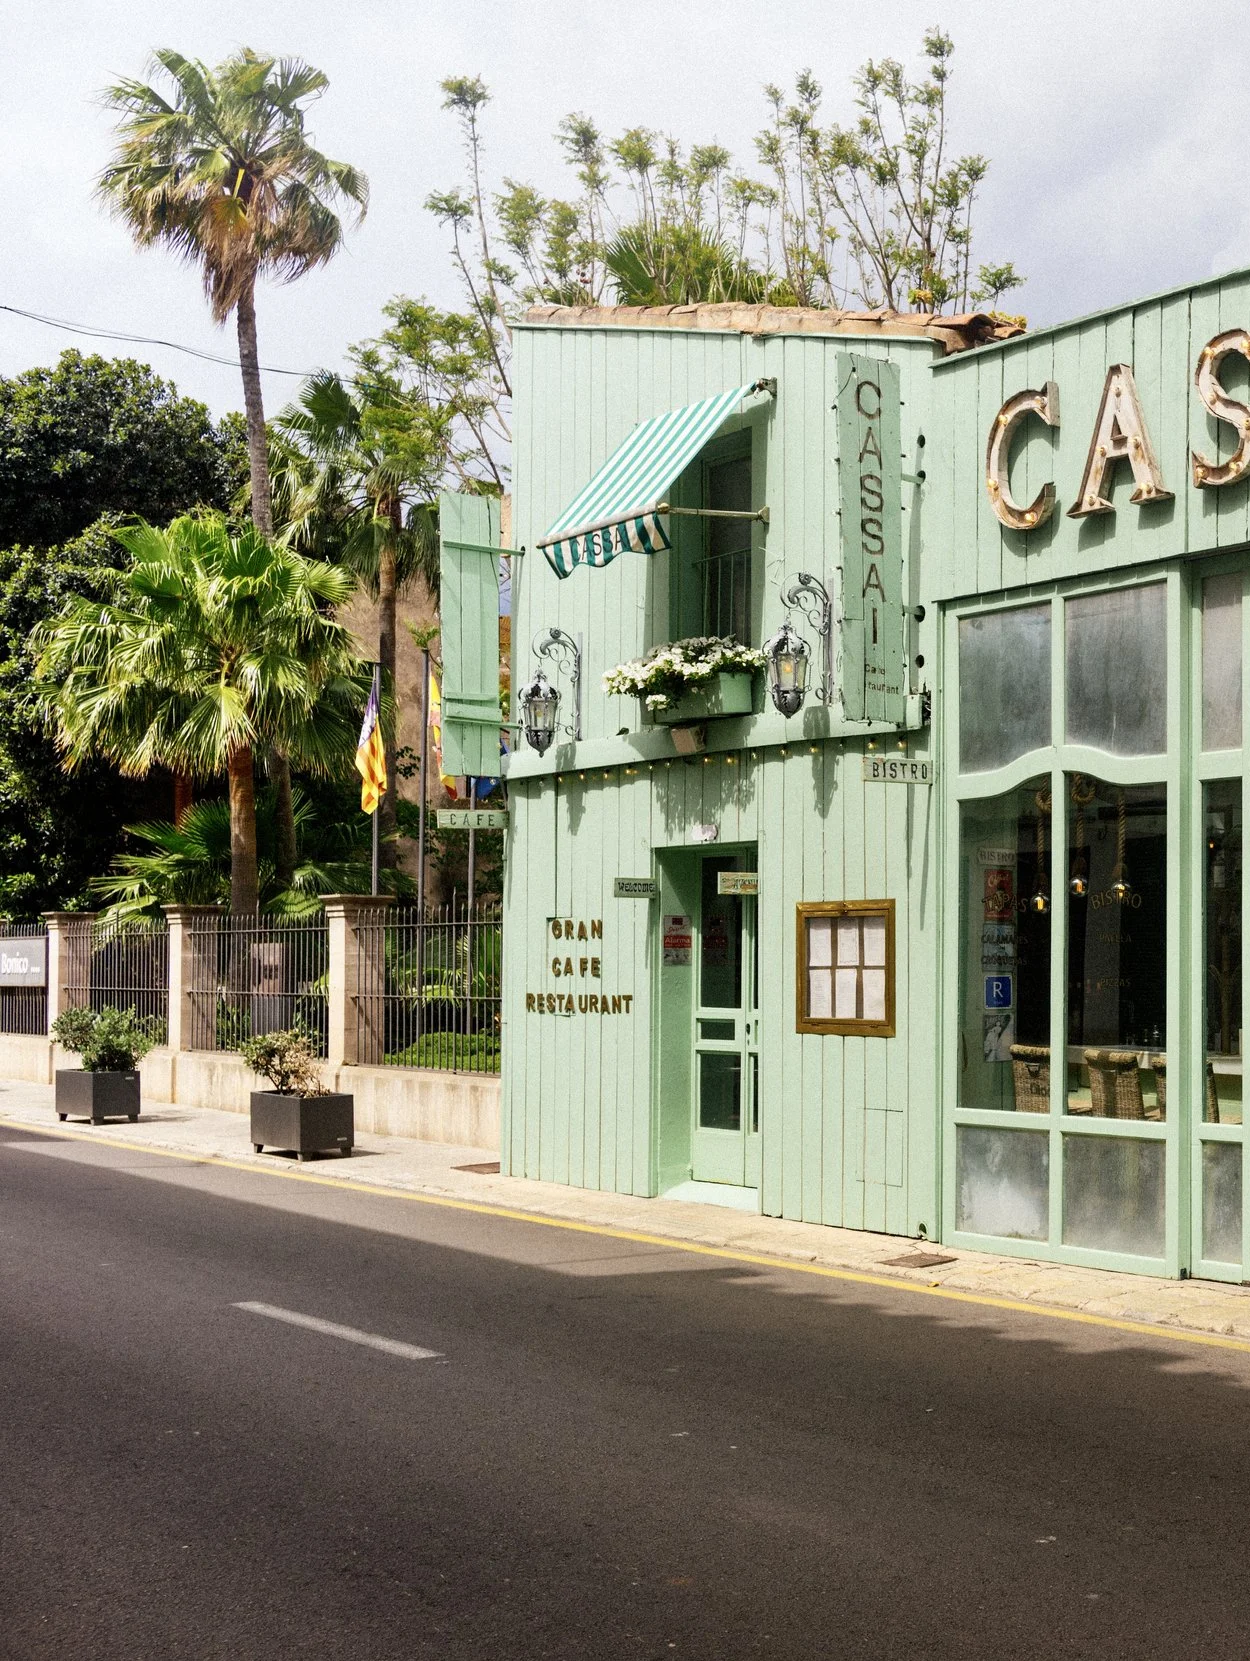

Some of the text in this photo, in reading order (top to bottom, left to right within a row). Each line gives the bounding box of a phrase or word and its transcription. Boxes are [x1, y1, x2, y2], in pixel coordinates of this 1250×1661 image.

[855, 380, 885, 644] CASSAI
[873, 762, 928, 779] BISTRO
[450, 813, 495, 827] CAFE
[618, 882, 654, 892] WELCOME
[982, 893, 1028, 913] TAPAS
[1091, 890, 1143, 910] BISTRO
[552, 919, 602, 941] GRAN
[552, 957, 601, 978] CAFE
[992, 981, 1004, 999] R
[526, 993, 633, 1015] RESTAURANT
